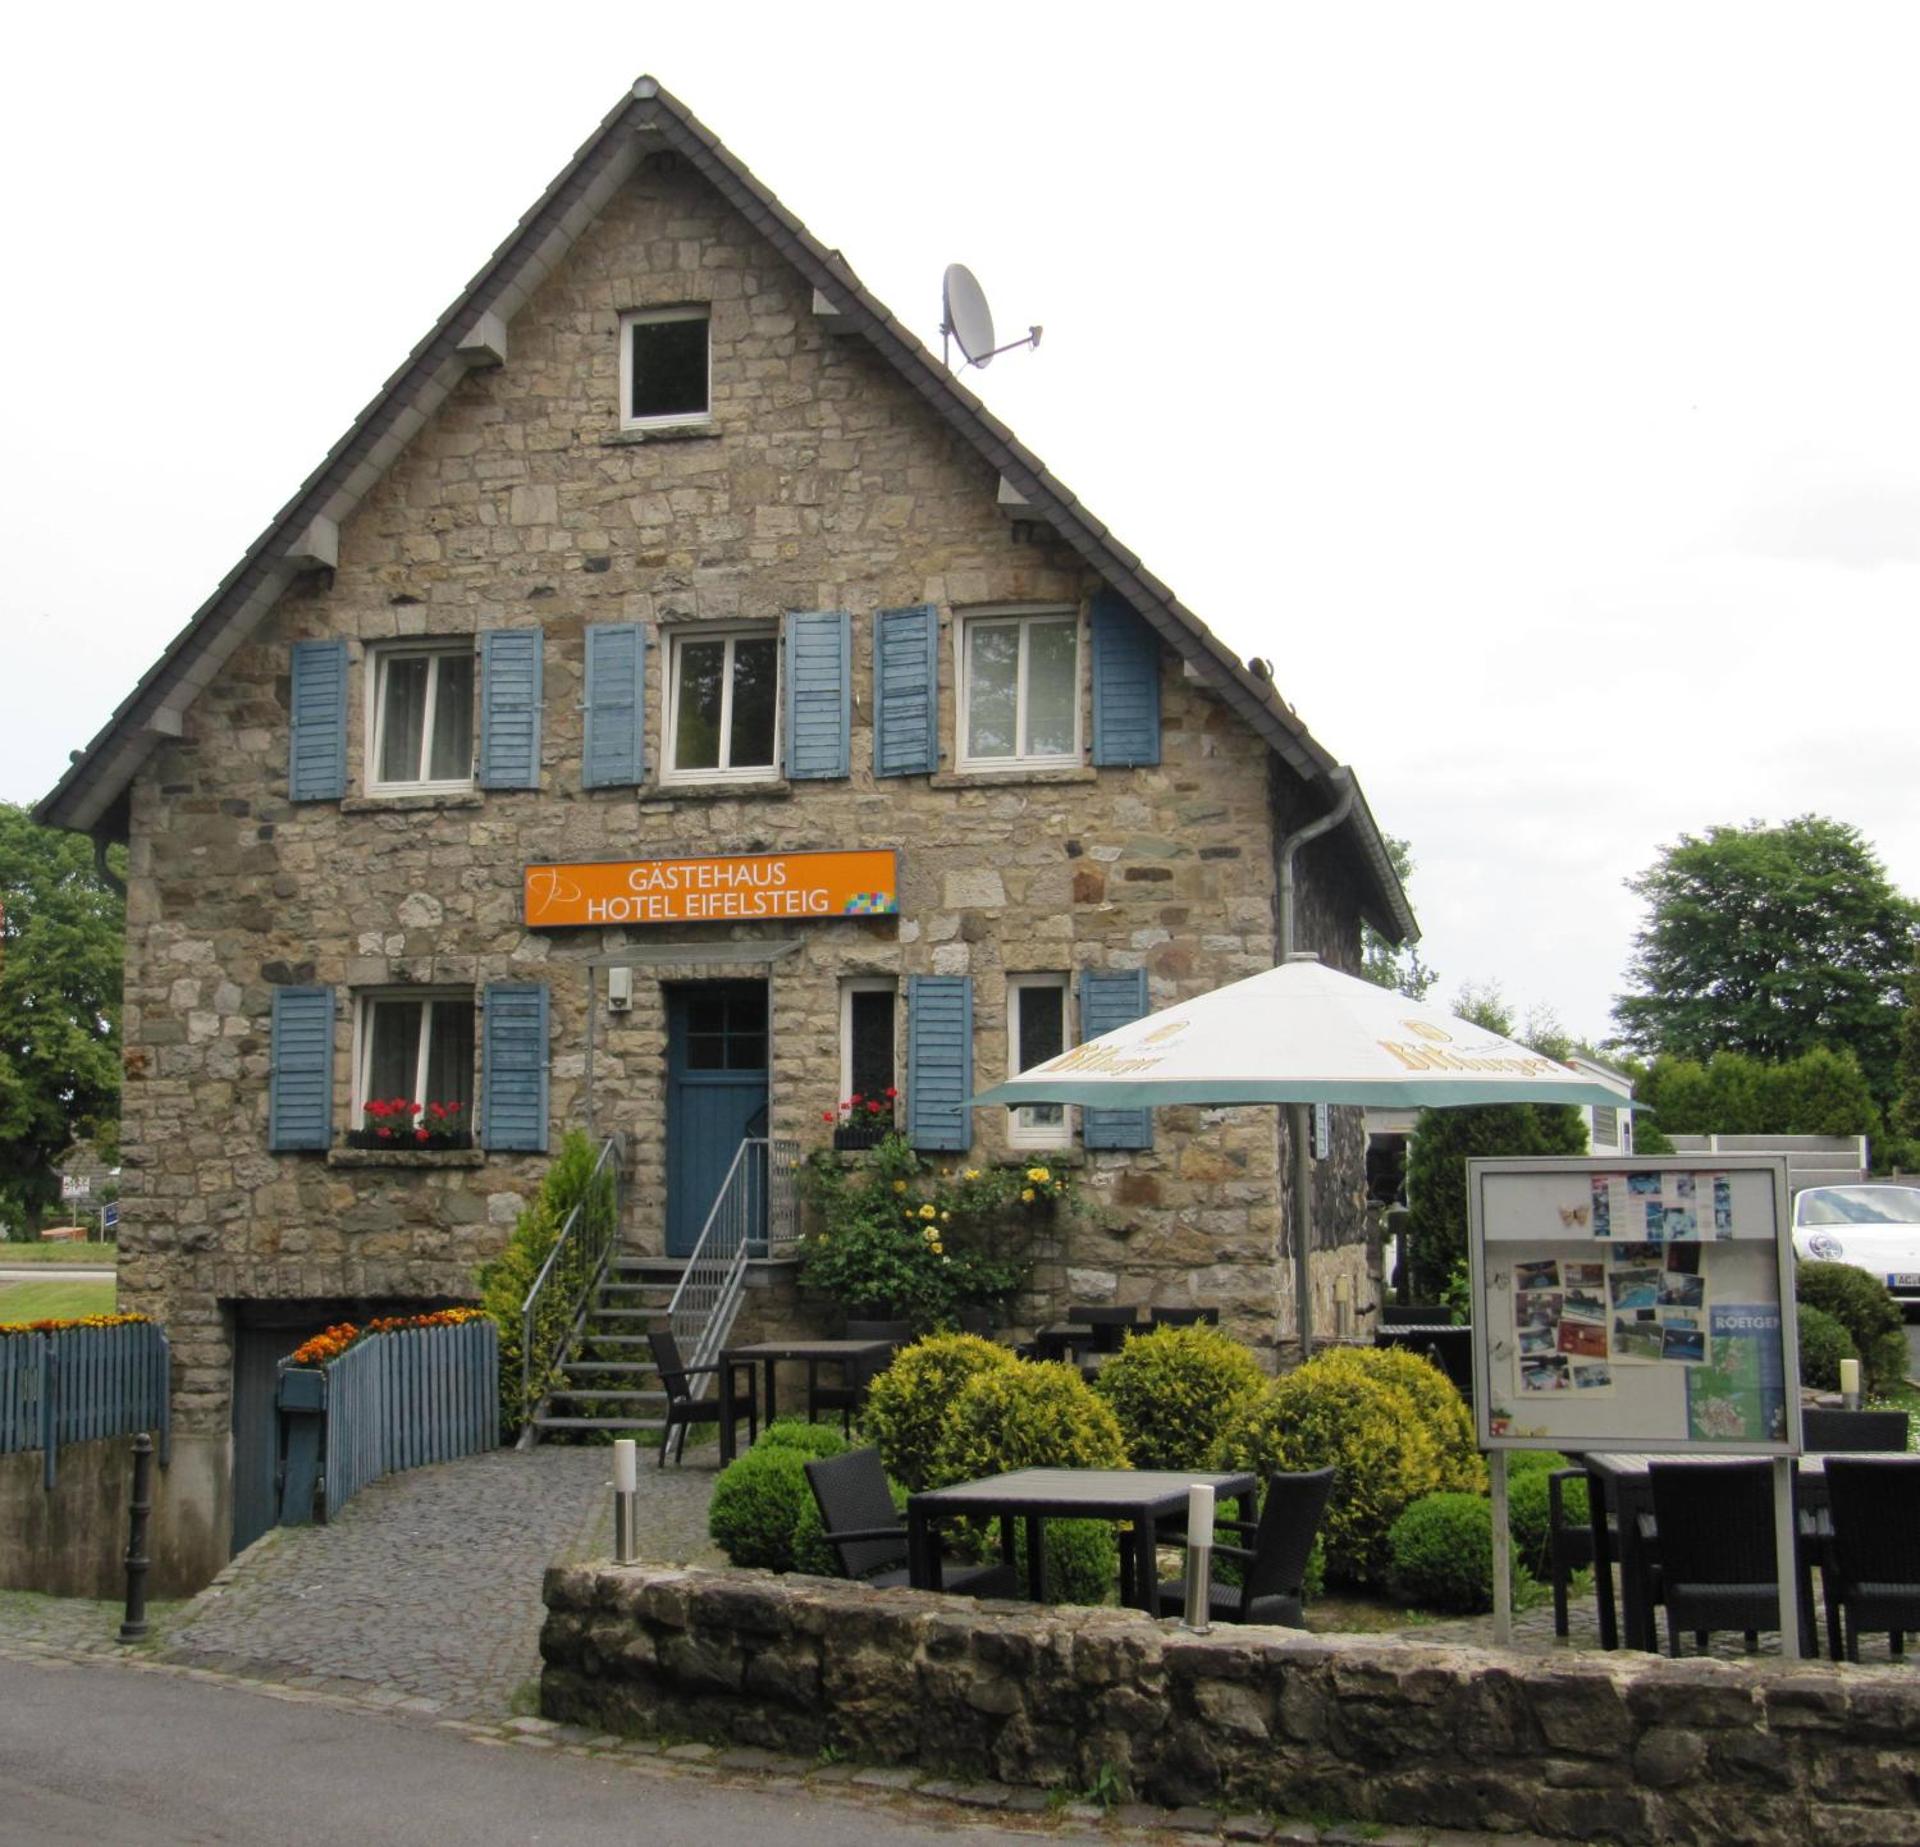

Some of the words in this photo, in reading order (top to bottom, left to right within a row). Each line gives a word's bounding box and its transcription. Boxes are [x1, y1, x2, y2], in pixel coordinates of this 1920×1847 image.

[628, 862, 786, 891] GÄSTEHAUS
[587, 895, 679, 920] HOTEL
[686, 889, 829, 917] EIFELSTEIG
